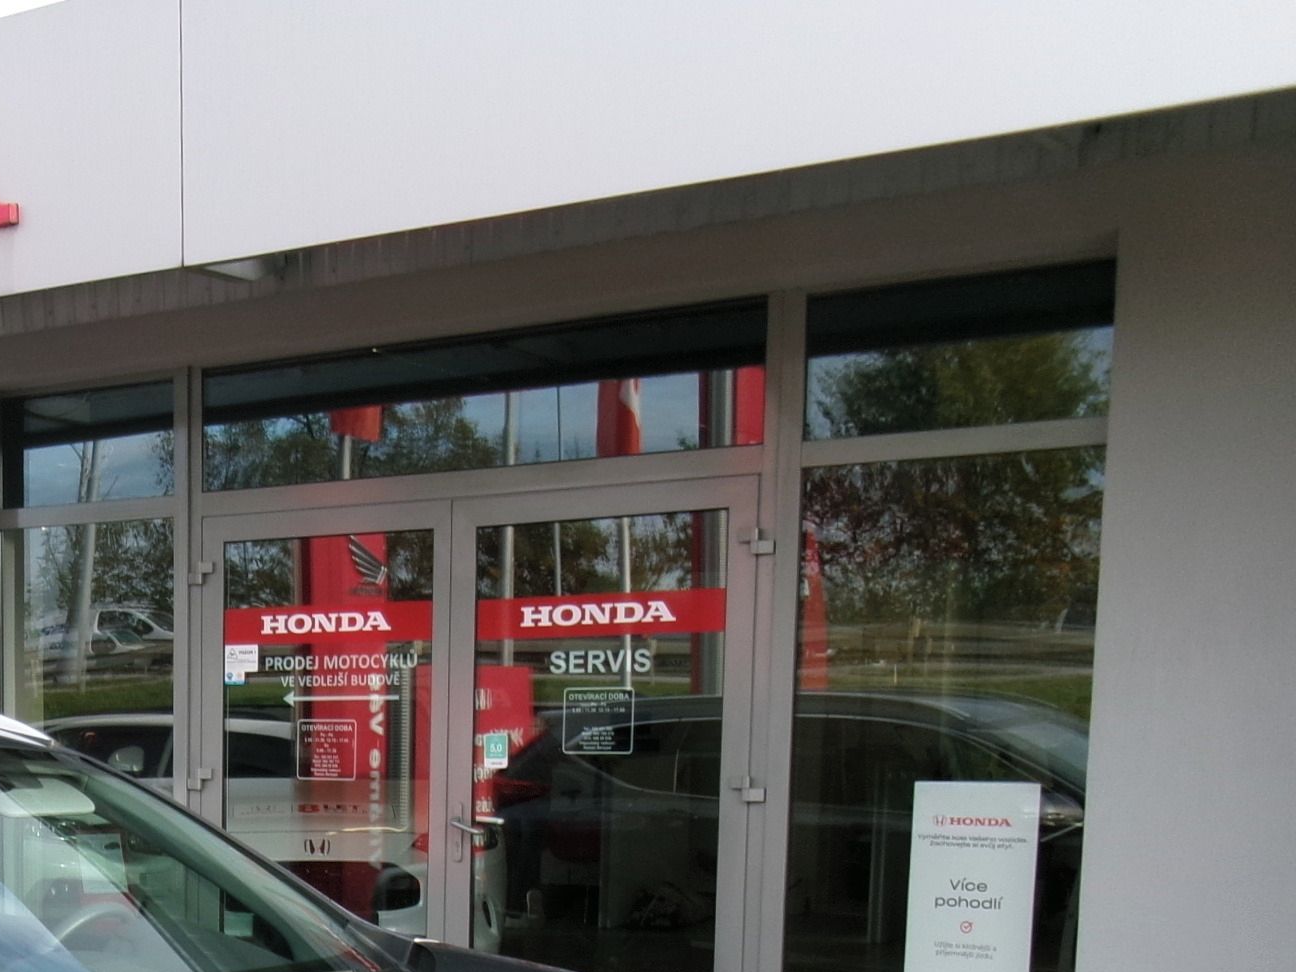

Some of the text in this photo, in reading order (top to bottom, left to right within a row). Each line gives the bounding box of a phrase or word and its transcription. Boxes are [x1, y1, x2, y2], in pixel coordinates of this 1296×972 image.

[261, 611, 391, 635] HONDA
[520, 600, 676, 628] HONDA
[265, 650, 418, 671] PRODEJ MOTOCYKLŮ
[549, 648, 651, 675] SERVIS
[281, 672, 400, 687] VE VEDLEJŠÍ BUDOVĚ
[949, 817, 1012, 828] HONDA
[950, 877, 988, 892] Více
[934, 896, 1004, 910] pohodlí
